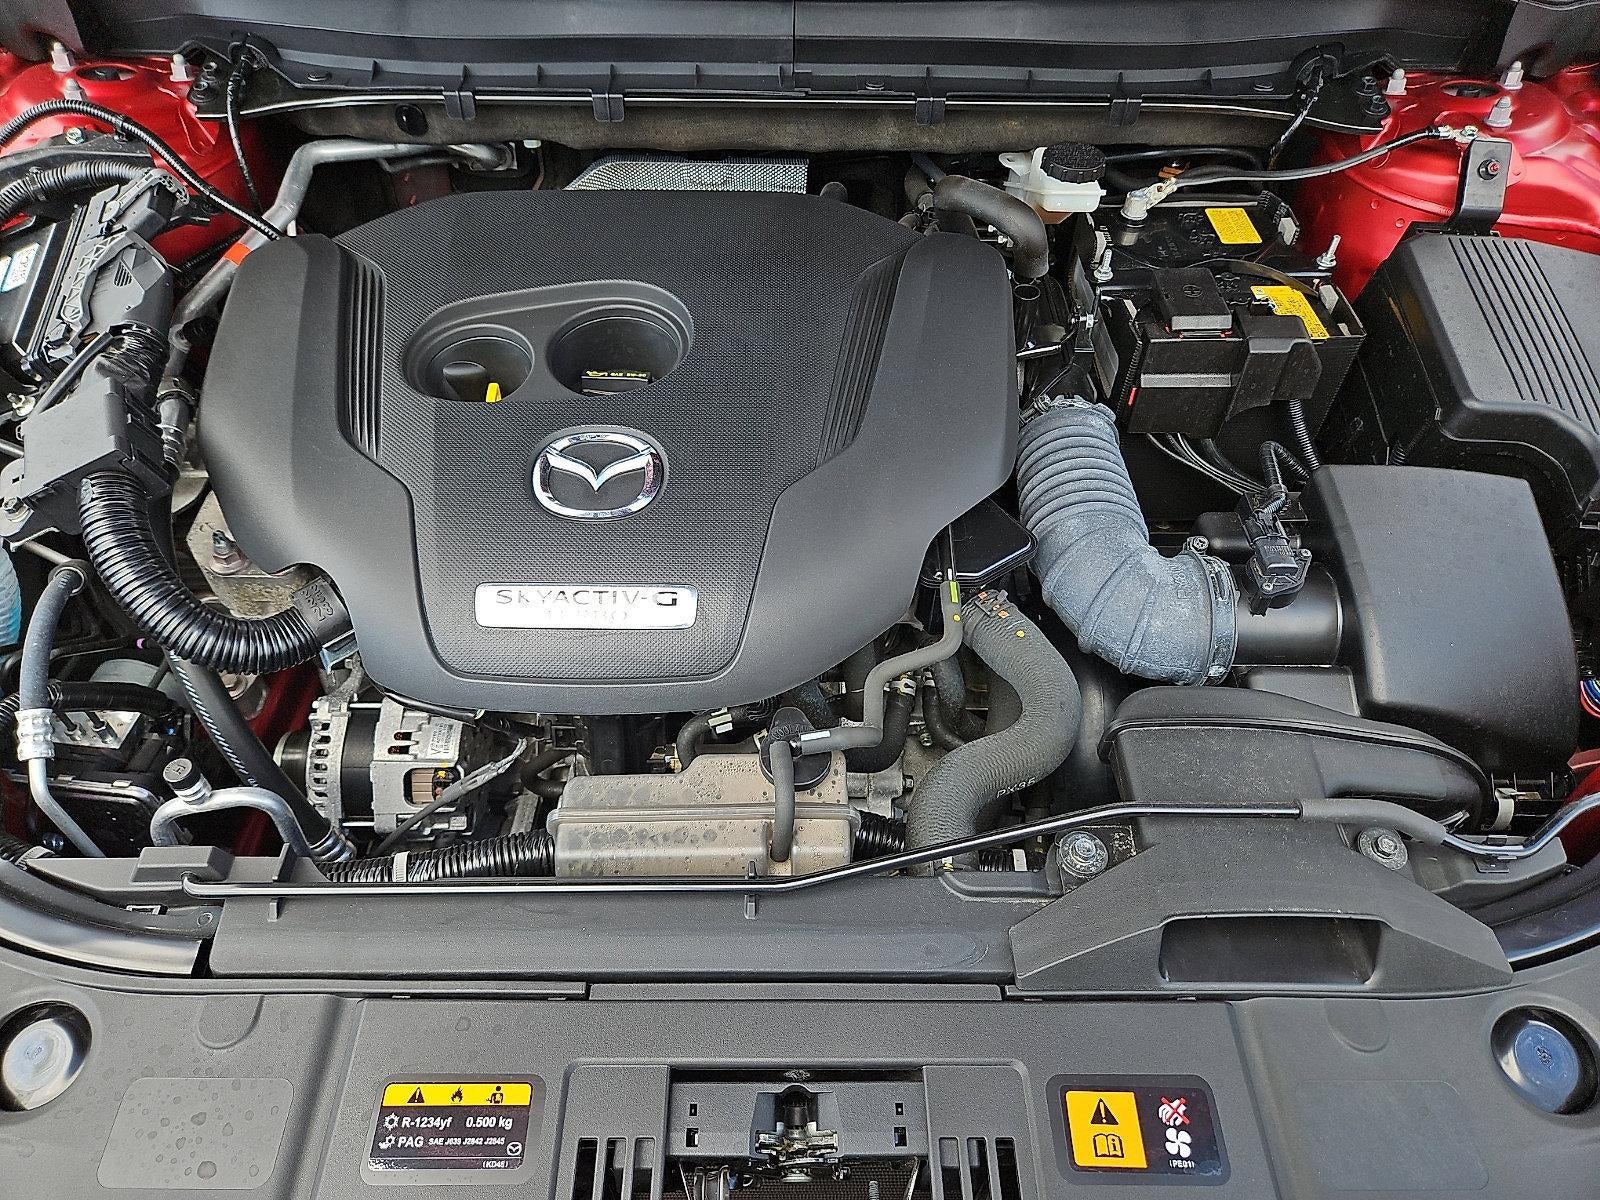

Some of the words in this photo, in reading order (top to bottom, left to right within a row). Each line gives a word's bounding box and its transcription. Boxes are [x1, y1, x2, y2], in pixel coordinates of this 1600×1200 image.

[495, 589, 679, 607] SKYACTIV-G
[401, 1116, 453, 1131] R-1234yf
[465, 1117, 497, 1128] 0.500
[498, 1116, 513, 1131] kg
[397, 1136, 424, 1148] PAG
[428, 1137, 444, 1146] SAE
